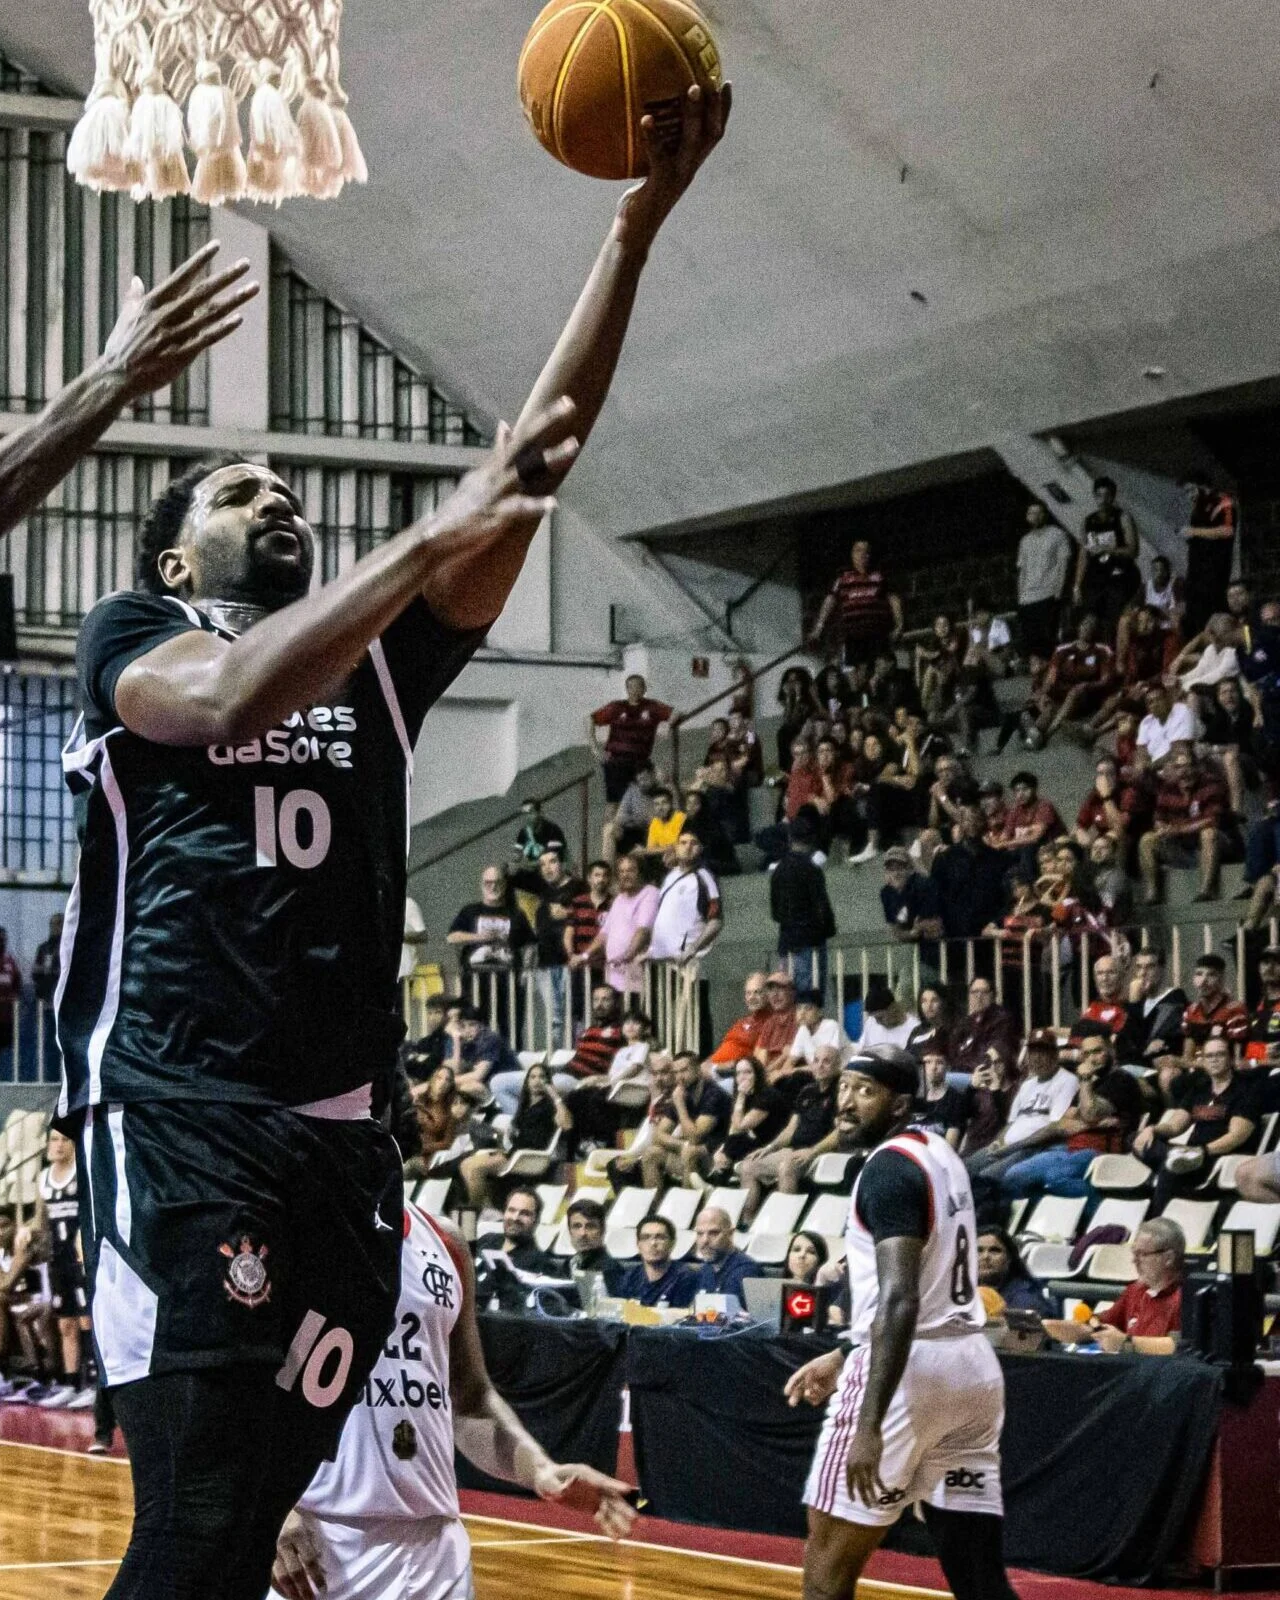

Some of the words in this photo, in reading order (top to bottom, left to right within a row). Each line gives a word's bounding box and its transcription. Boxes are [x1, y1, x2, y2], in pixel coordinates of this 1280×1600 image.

[254, 785, 332, 870] 10
[950, 1223, 974, 1306] 8
[275, 1308, 354, 1408] 10
[945, 1467, 986, 1489] abc
